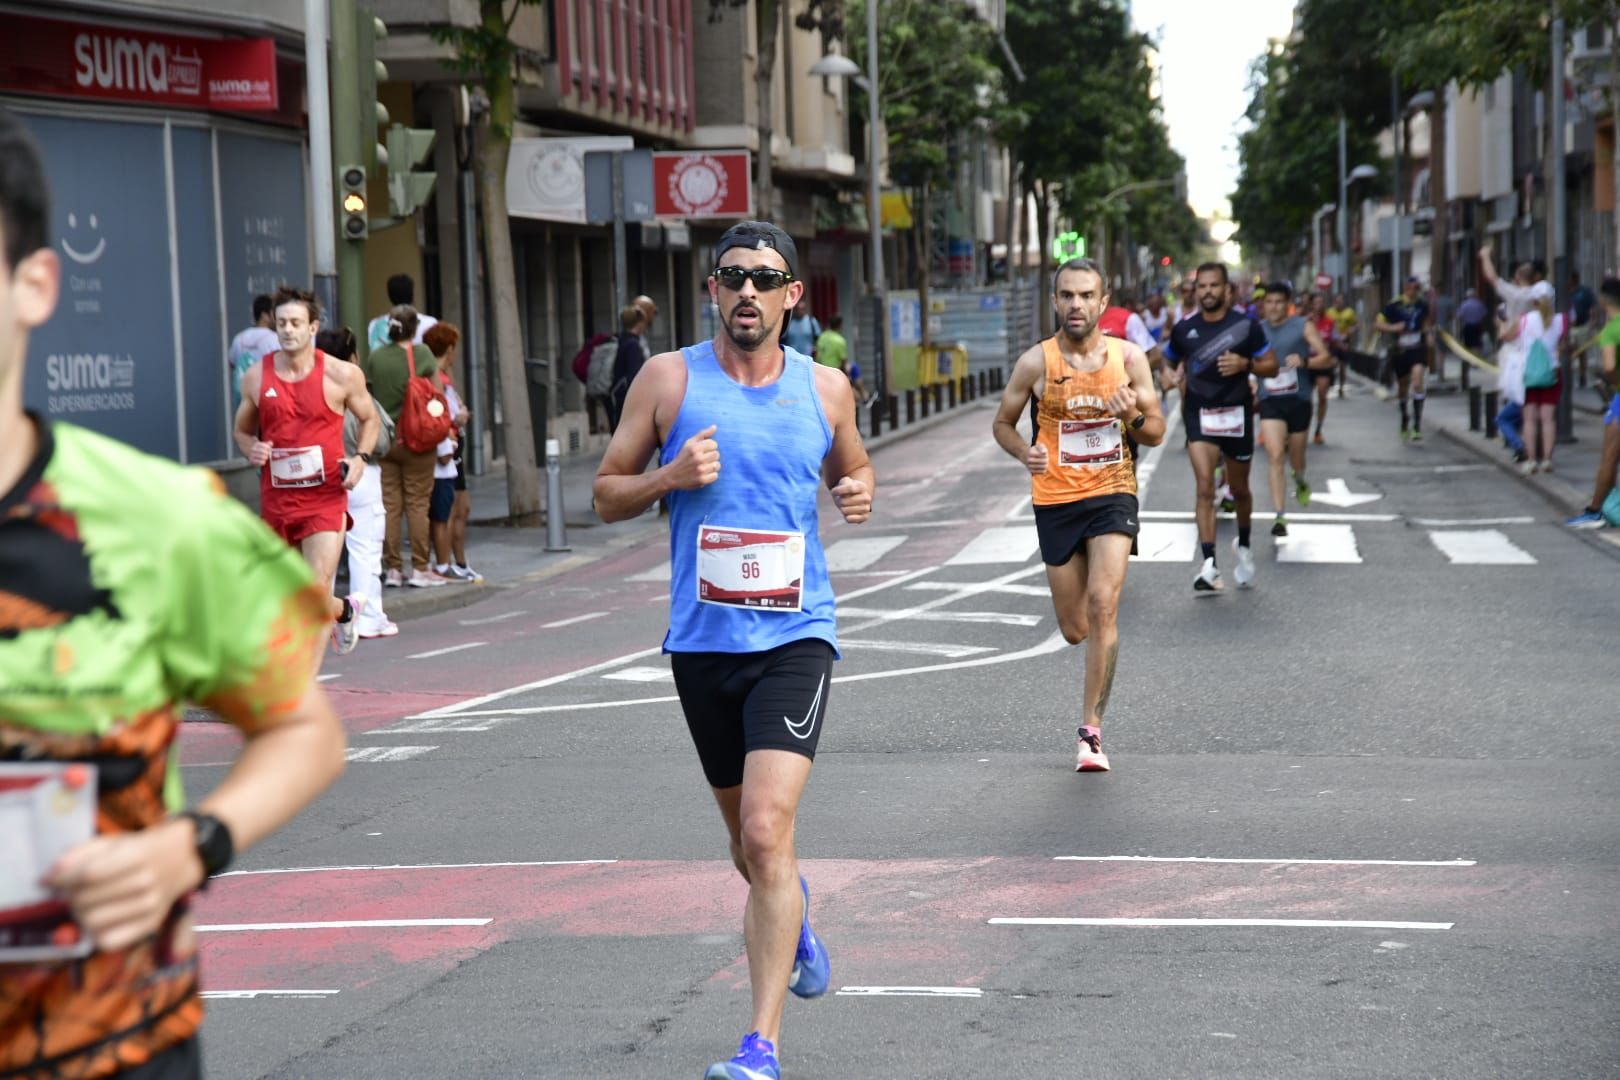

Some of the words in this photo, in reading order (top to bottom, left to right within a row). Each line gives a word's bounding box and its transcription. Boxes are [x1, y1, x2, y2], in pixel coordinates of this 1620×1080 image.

[75, 32, 168, 93] suma
[208, 79, 251, 94] suma
[47, 353, 111, 391] suma
[48, 393, 136, 413] SUPERMERCADOS
[741, 561, 760, 579] 96
